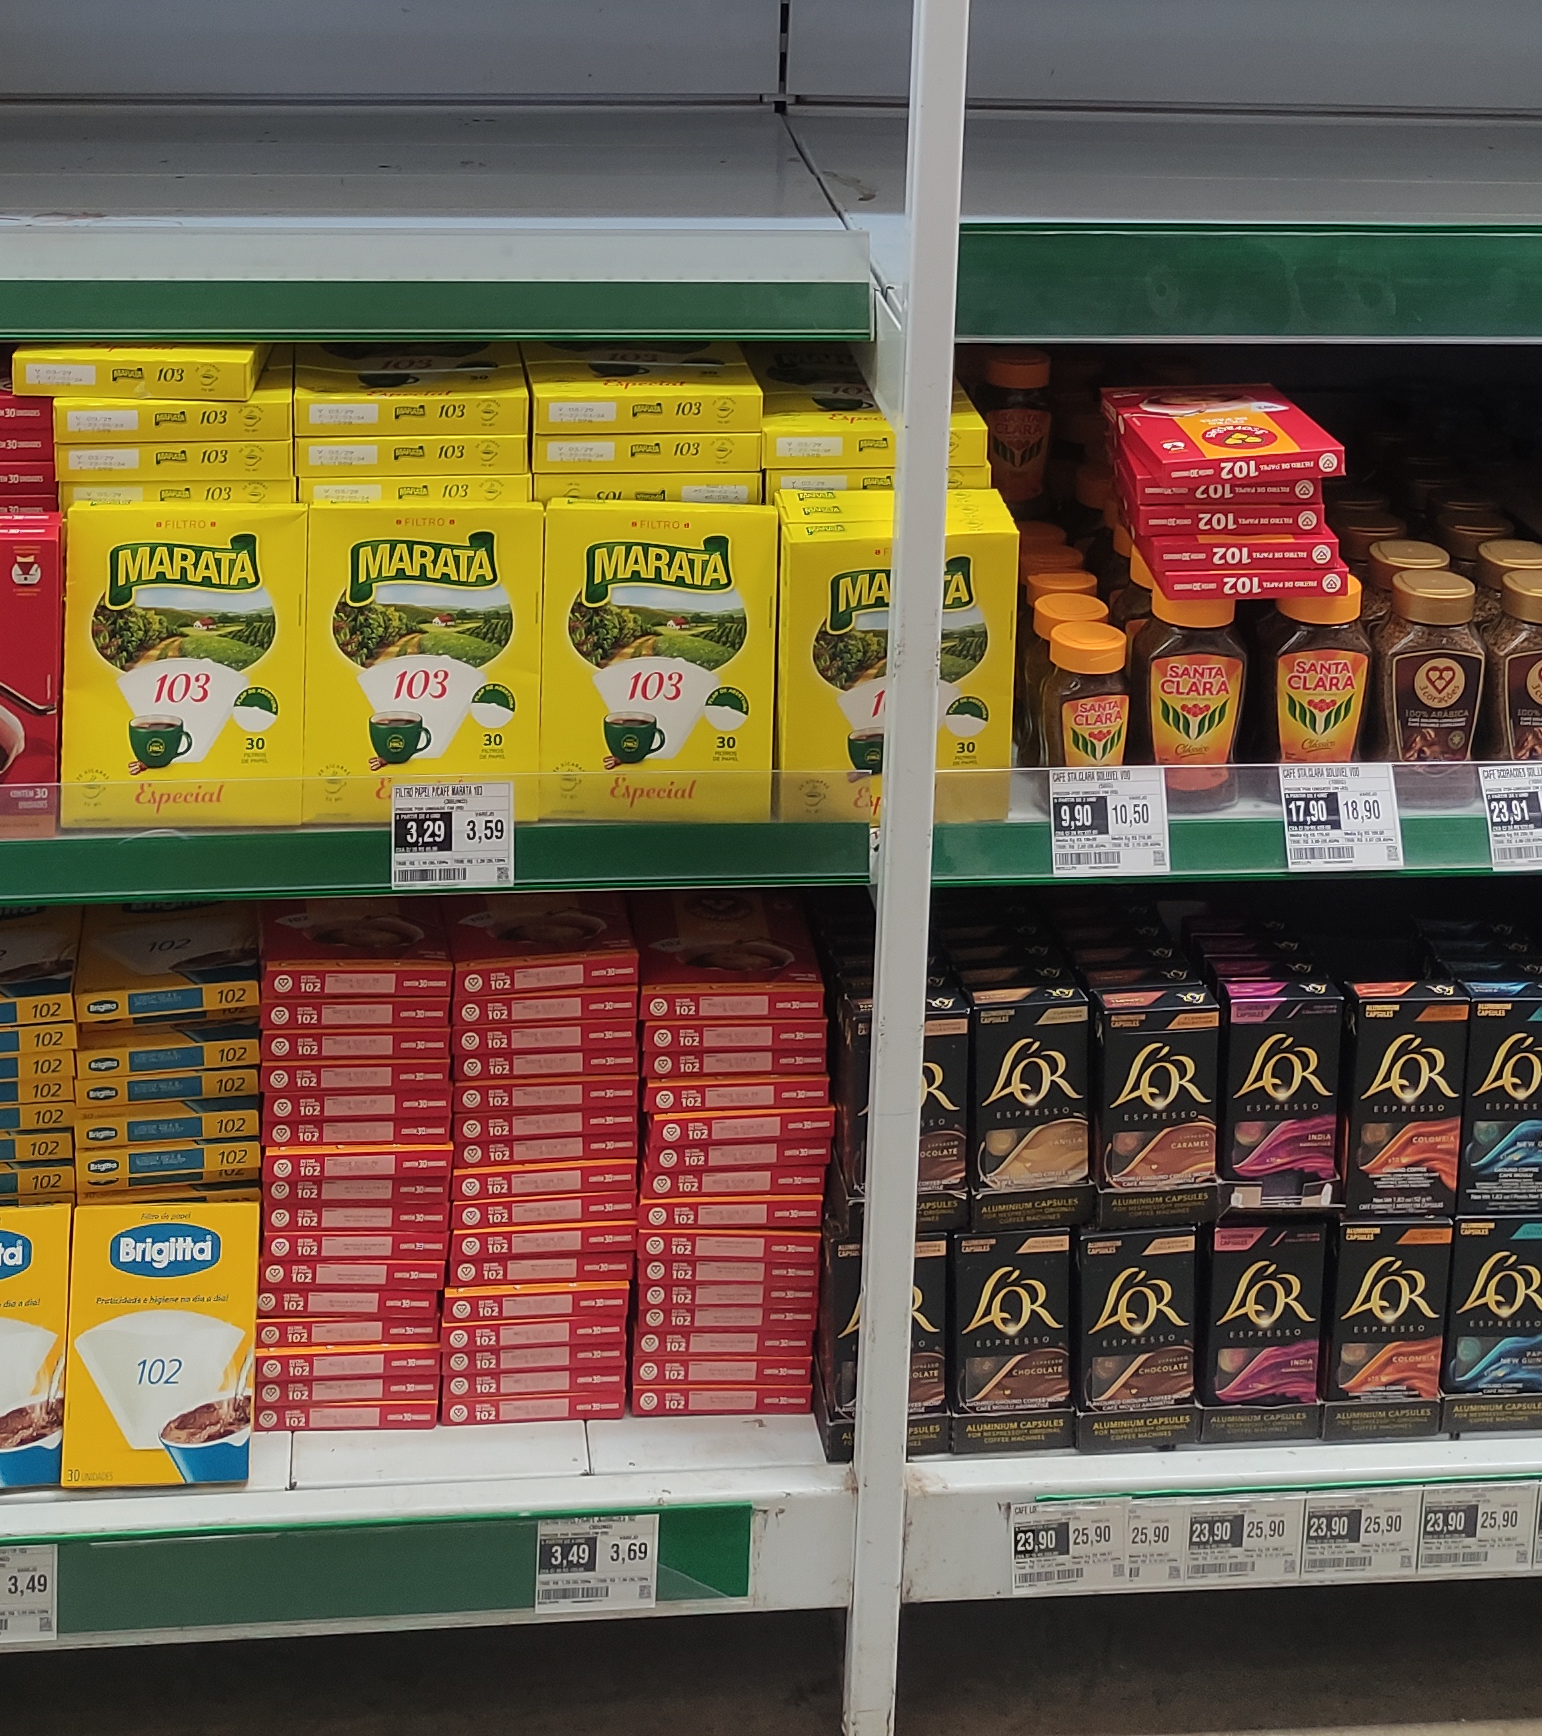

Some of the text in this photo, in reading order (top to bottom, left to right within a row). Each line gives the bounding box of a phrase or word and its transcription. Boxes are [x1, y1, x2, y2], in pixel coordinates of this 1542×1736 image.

[165, 519, 207, 529] FILTRO
[117, 544, 257, 589] MARATÁ
[1167, 665, 1224, 680] SANTA
[154, 673, 211, 705] 103
[1160, 678, 1230, 697] CLARA
[245, 738, 265, 751] 30
[134, 783, 225, 814] Especial
[1061, 805, 1149, 827] 9,90 10,50
[1289, 800, 1381, 823] 17,90 18,90
[406, 819, 504, 845] 3,29 3,59
[981, 1038, 1083, 1106] L'OR
[996, 1107, 1069, 1119] ESPRESSO
[1412, 1136, 1454, 1144] COLOMBIA
[1191, 1520, 1286, 1545] 23,90 25,90
[550, 1540, 648, 1568] 3,49 3,69
[7, 1574, 48, 1596] 3,49
